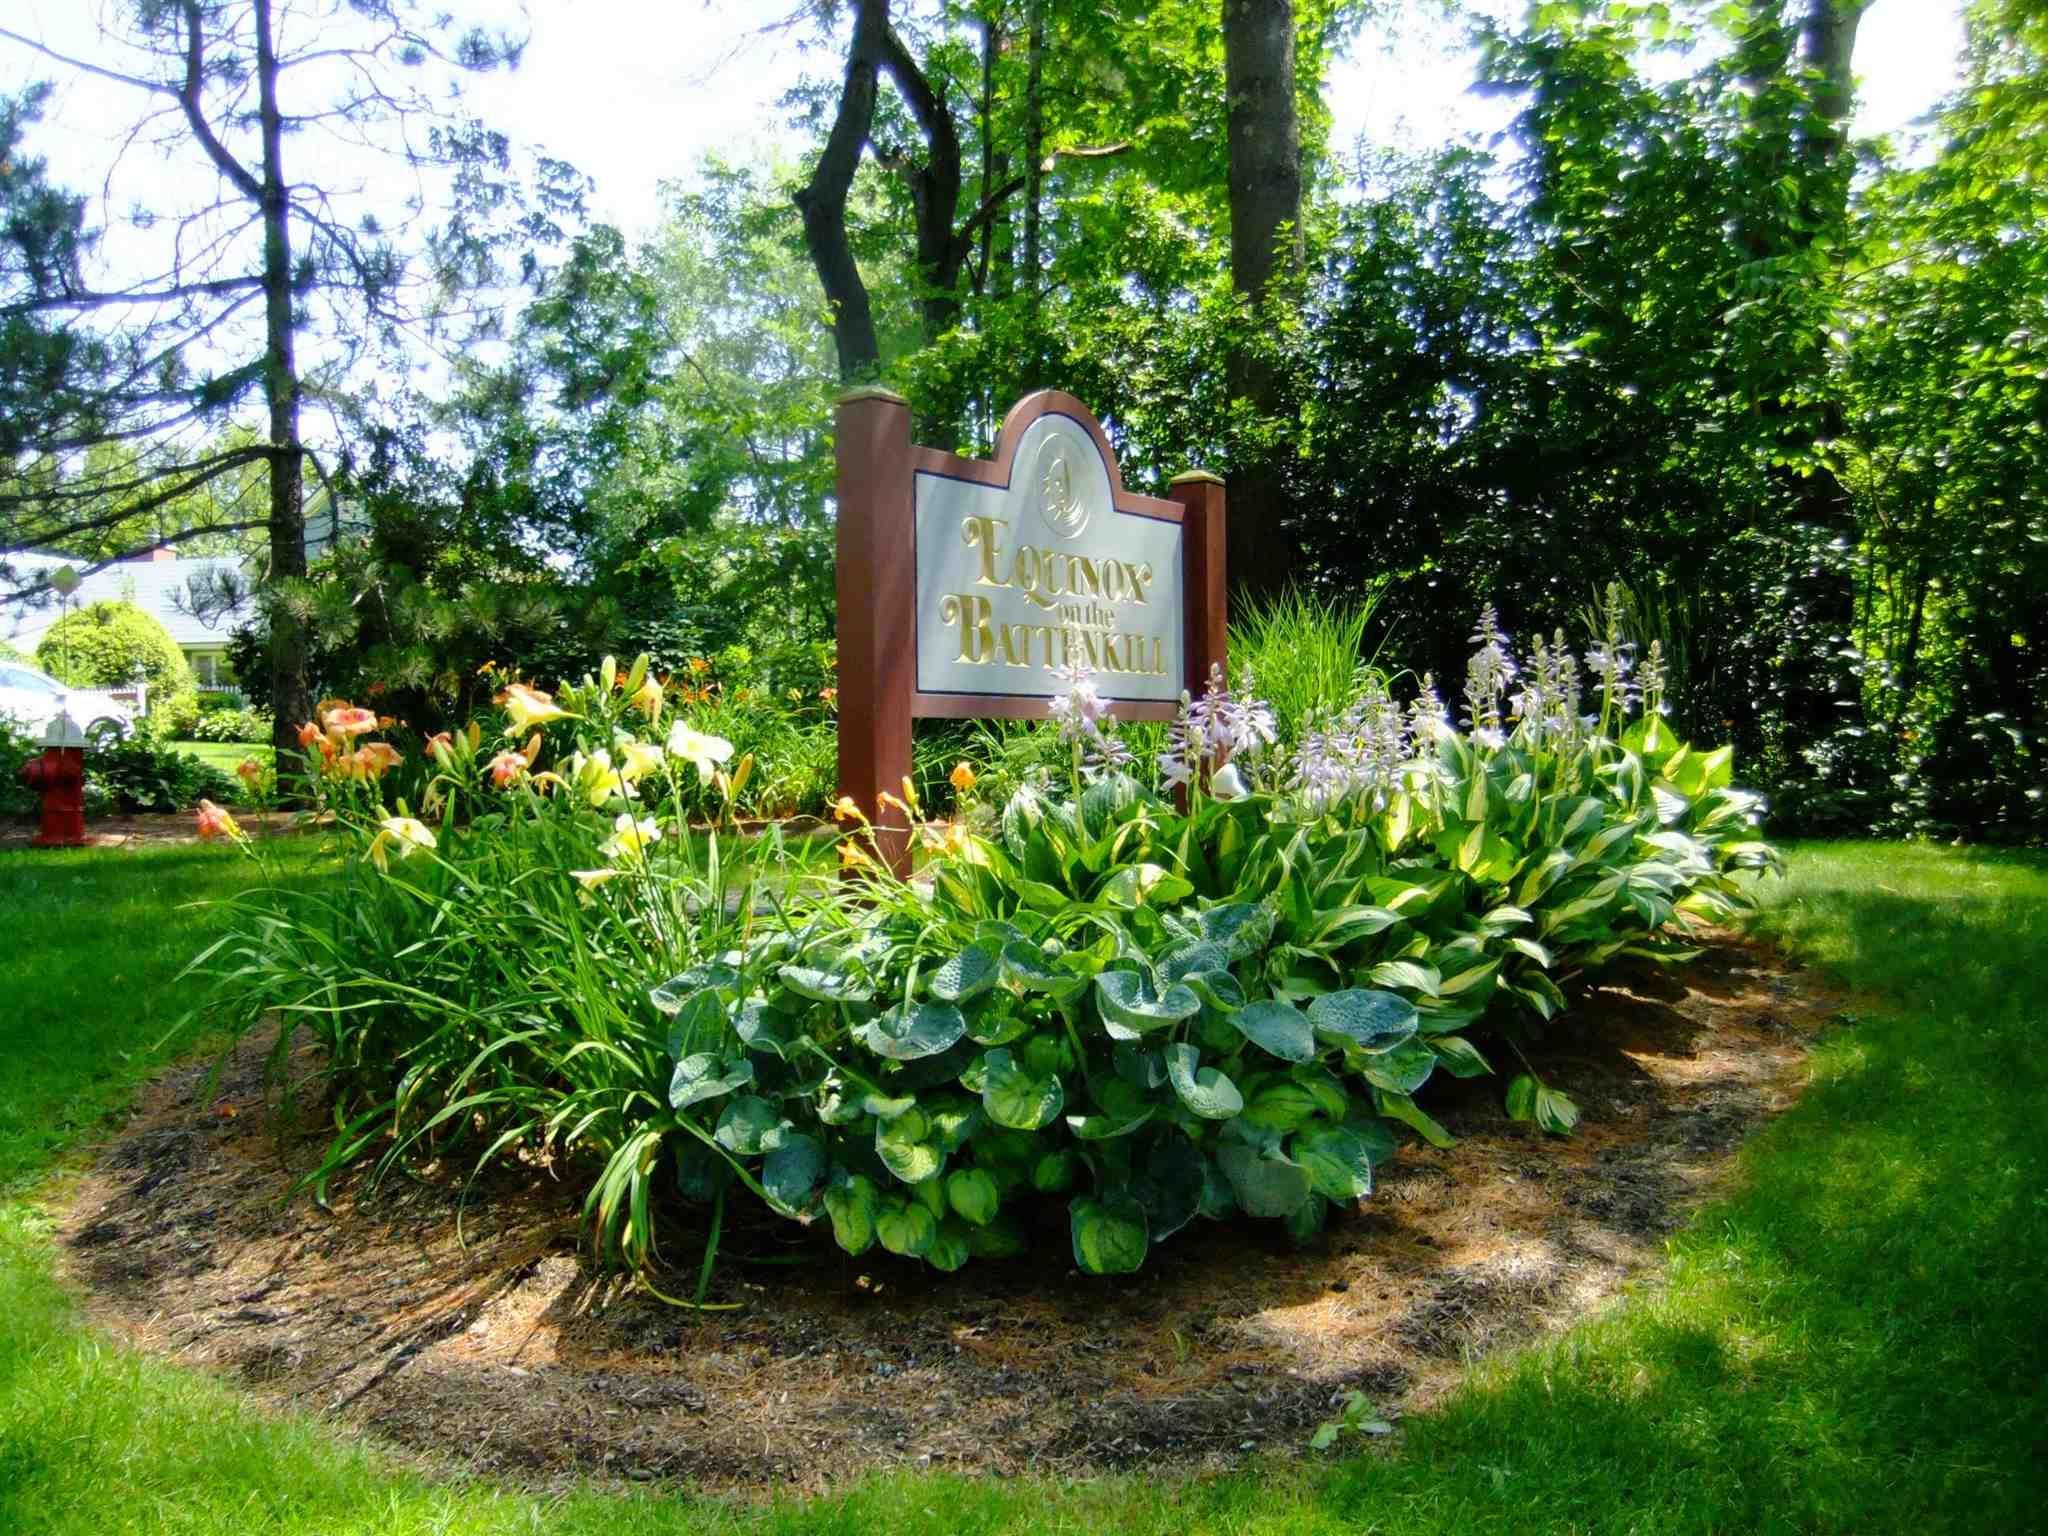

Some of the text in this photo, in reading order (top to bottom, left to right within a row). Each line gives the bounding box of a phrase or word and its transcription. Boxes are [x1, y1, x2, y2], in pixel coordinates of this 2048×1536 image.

[961, 515, 1153, 610] EQUINOX
[1057, 599, 1115, 629] on the
